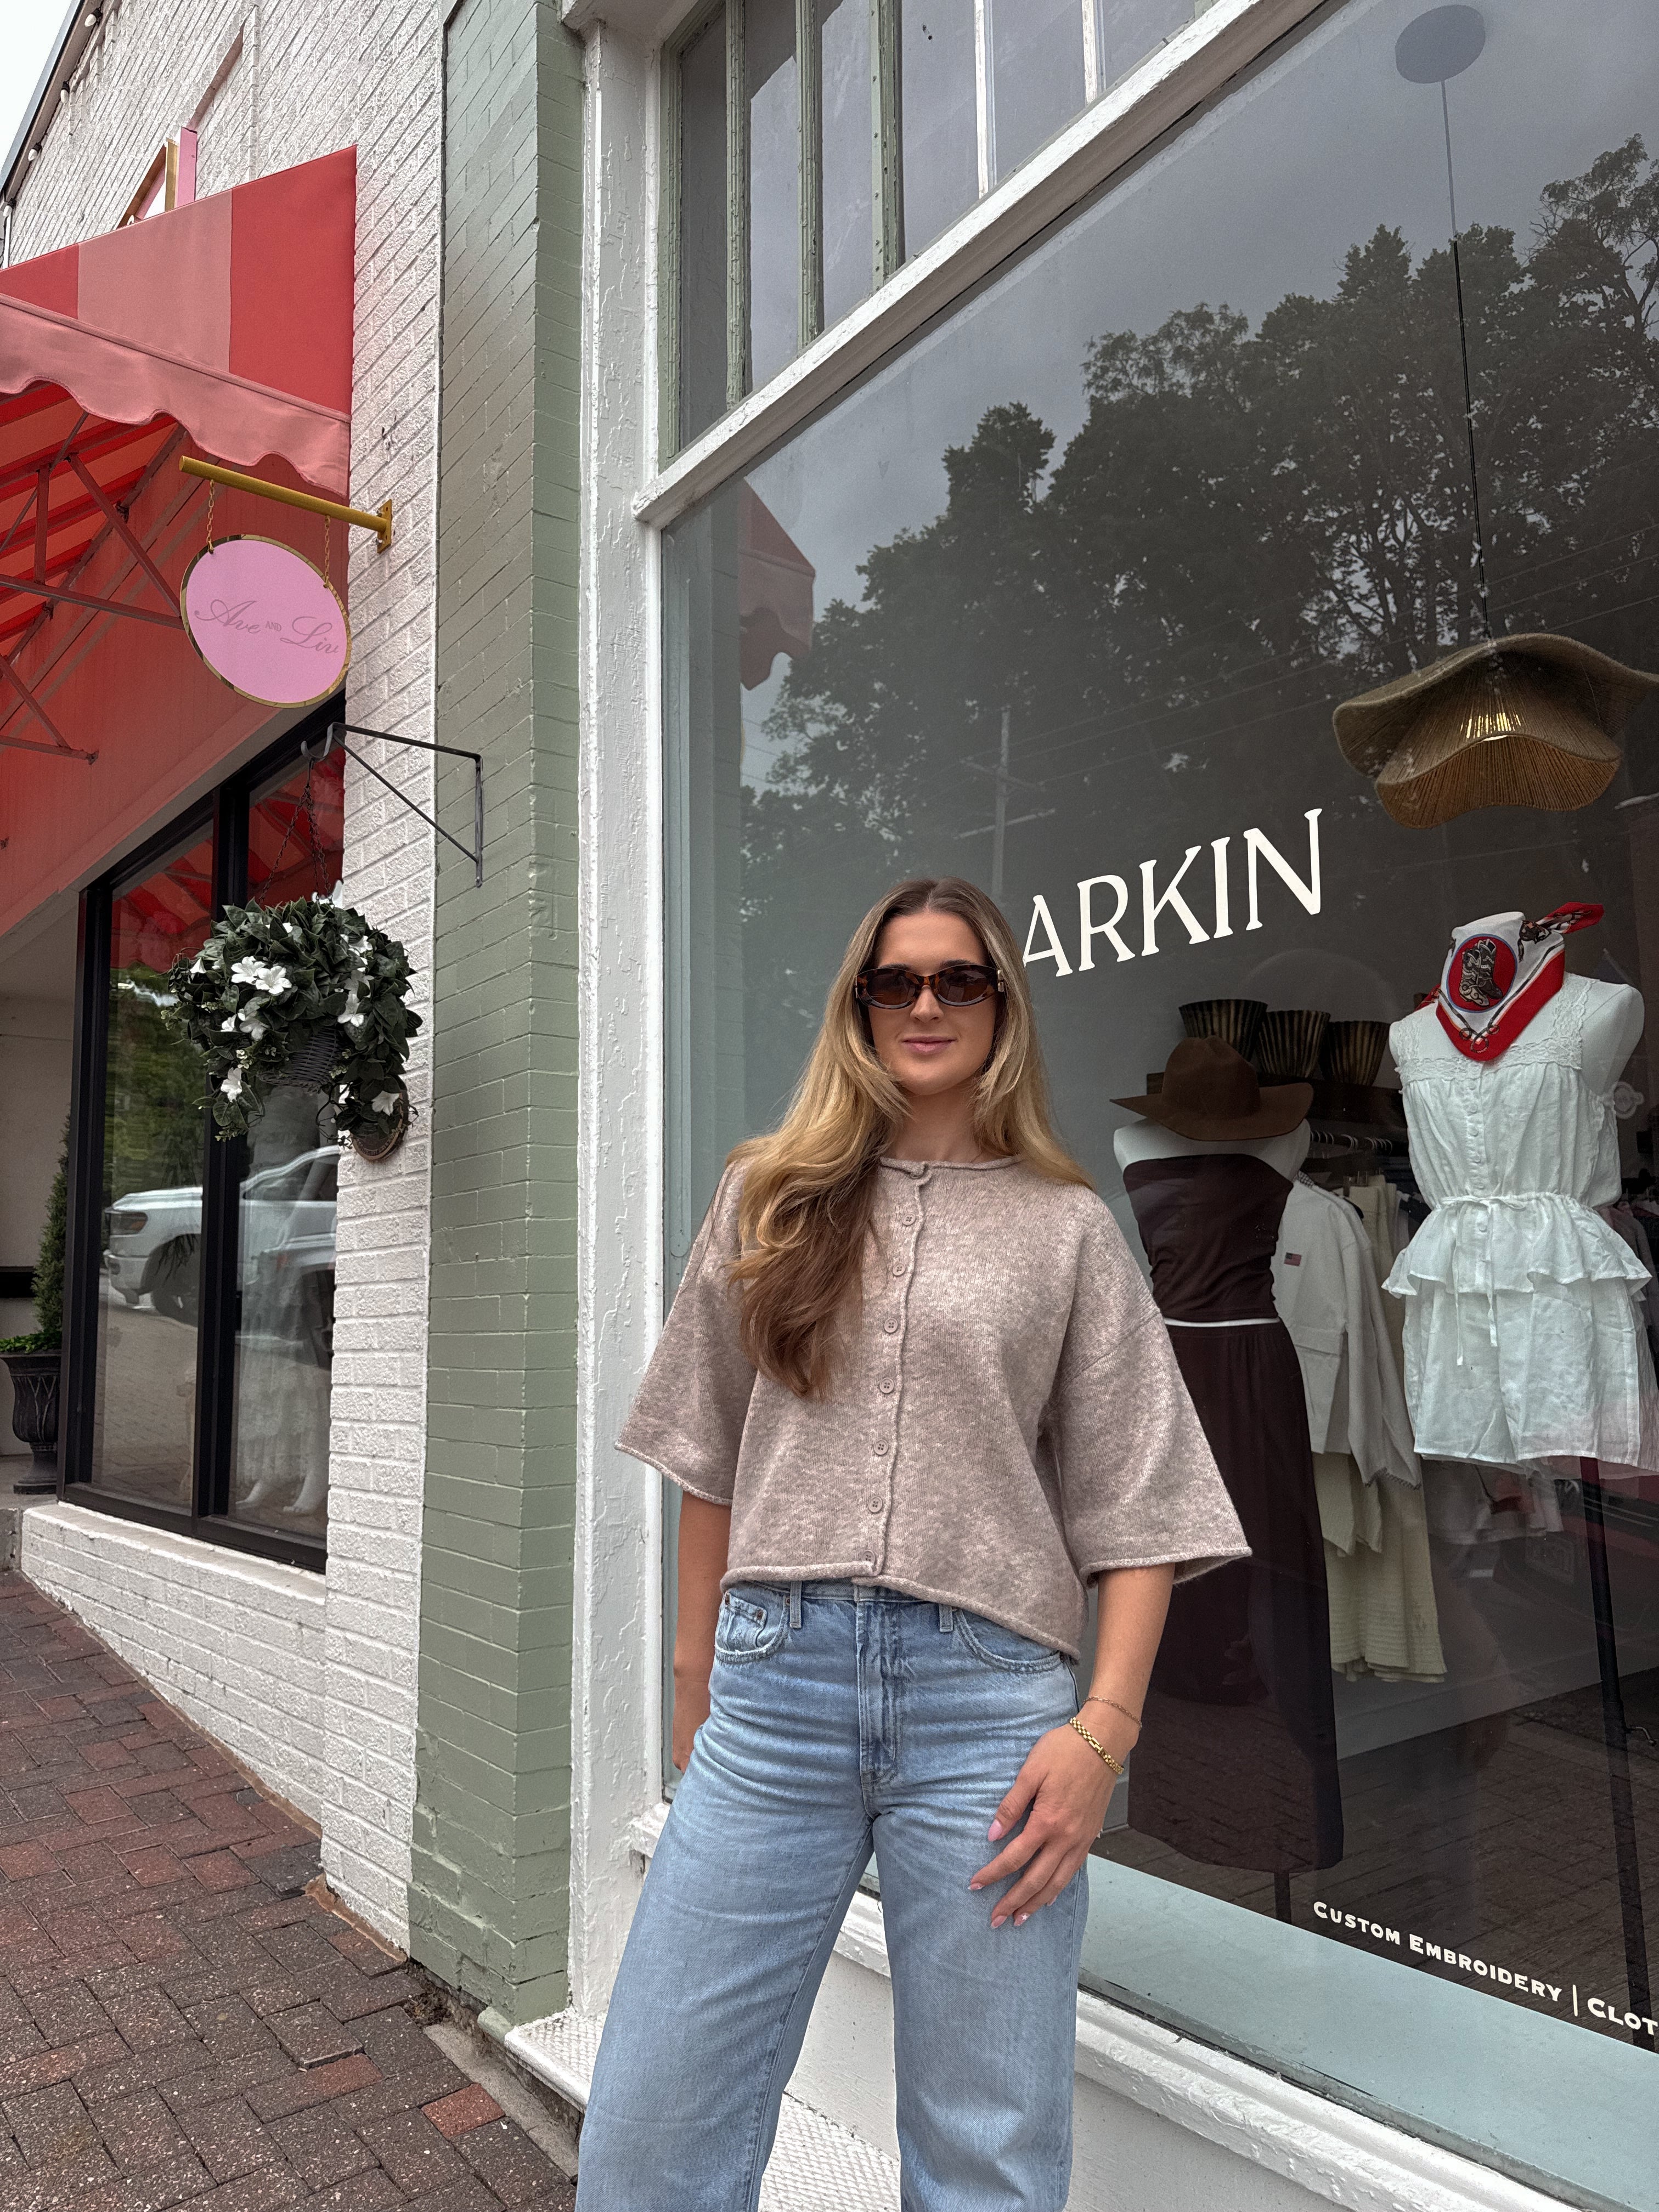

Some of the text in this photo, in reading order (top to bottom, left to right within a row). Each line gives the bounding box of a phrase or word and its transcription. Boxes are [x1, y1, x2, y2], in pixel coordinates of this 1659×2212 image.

[194, 599, 340, 654] Ave AND Liv
[1313, 1901, 1400, 1945] CUSTOM
[1409, 1933, 1562, 2002] EMBROIDERY
